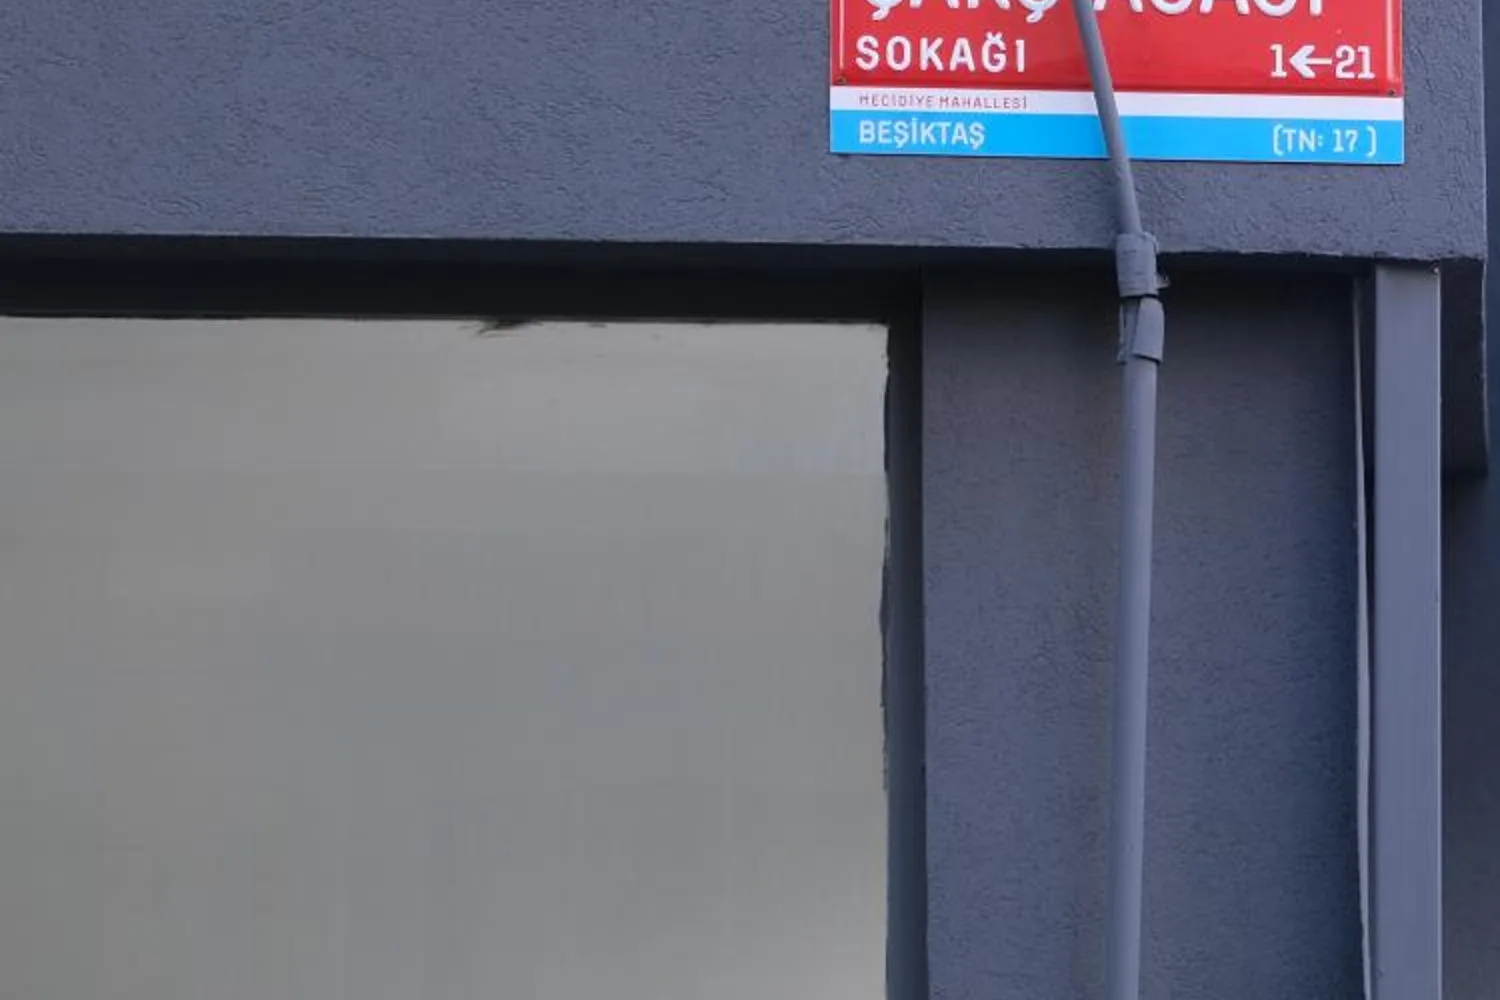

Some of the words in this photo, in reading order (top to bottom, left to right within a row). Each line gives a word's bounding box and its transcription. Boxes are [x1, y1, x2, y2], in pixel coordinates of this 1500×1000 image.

[855, 32, 1026, 73] SOKAĞI
[1269, 43, 1288, 78] 1
[1335, 45, 1376, 79] 21
[858, 90, 937, 108] MECİDİYE
[938, 94, 1028, 110] MAHALLESİ
[858, 117, 986, 149] BEŞİKTAŞ
